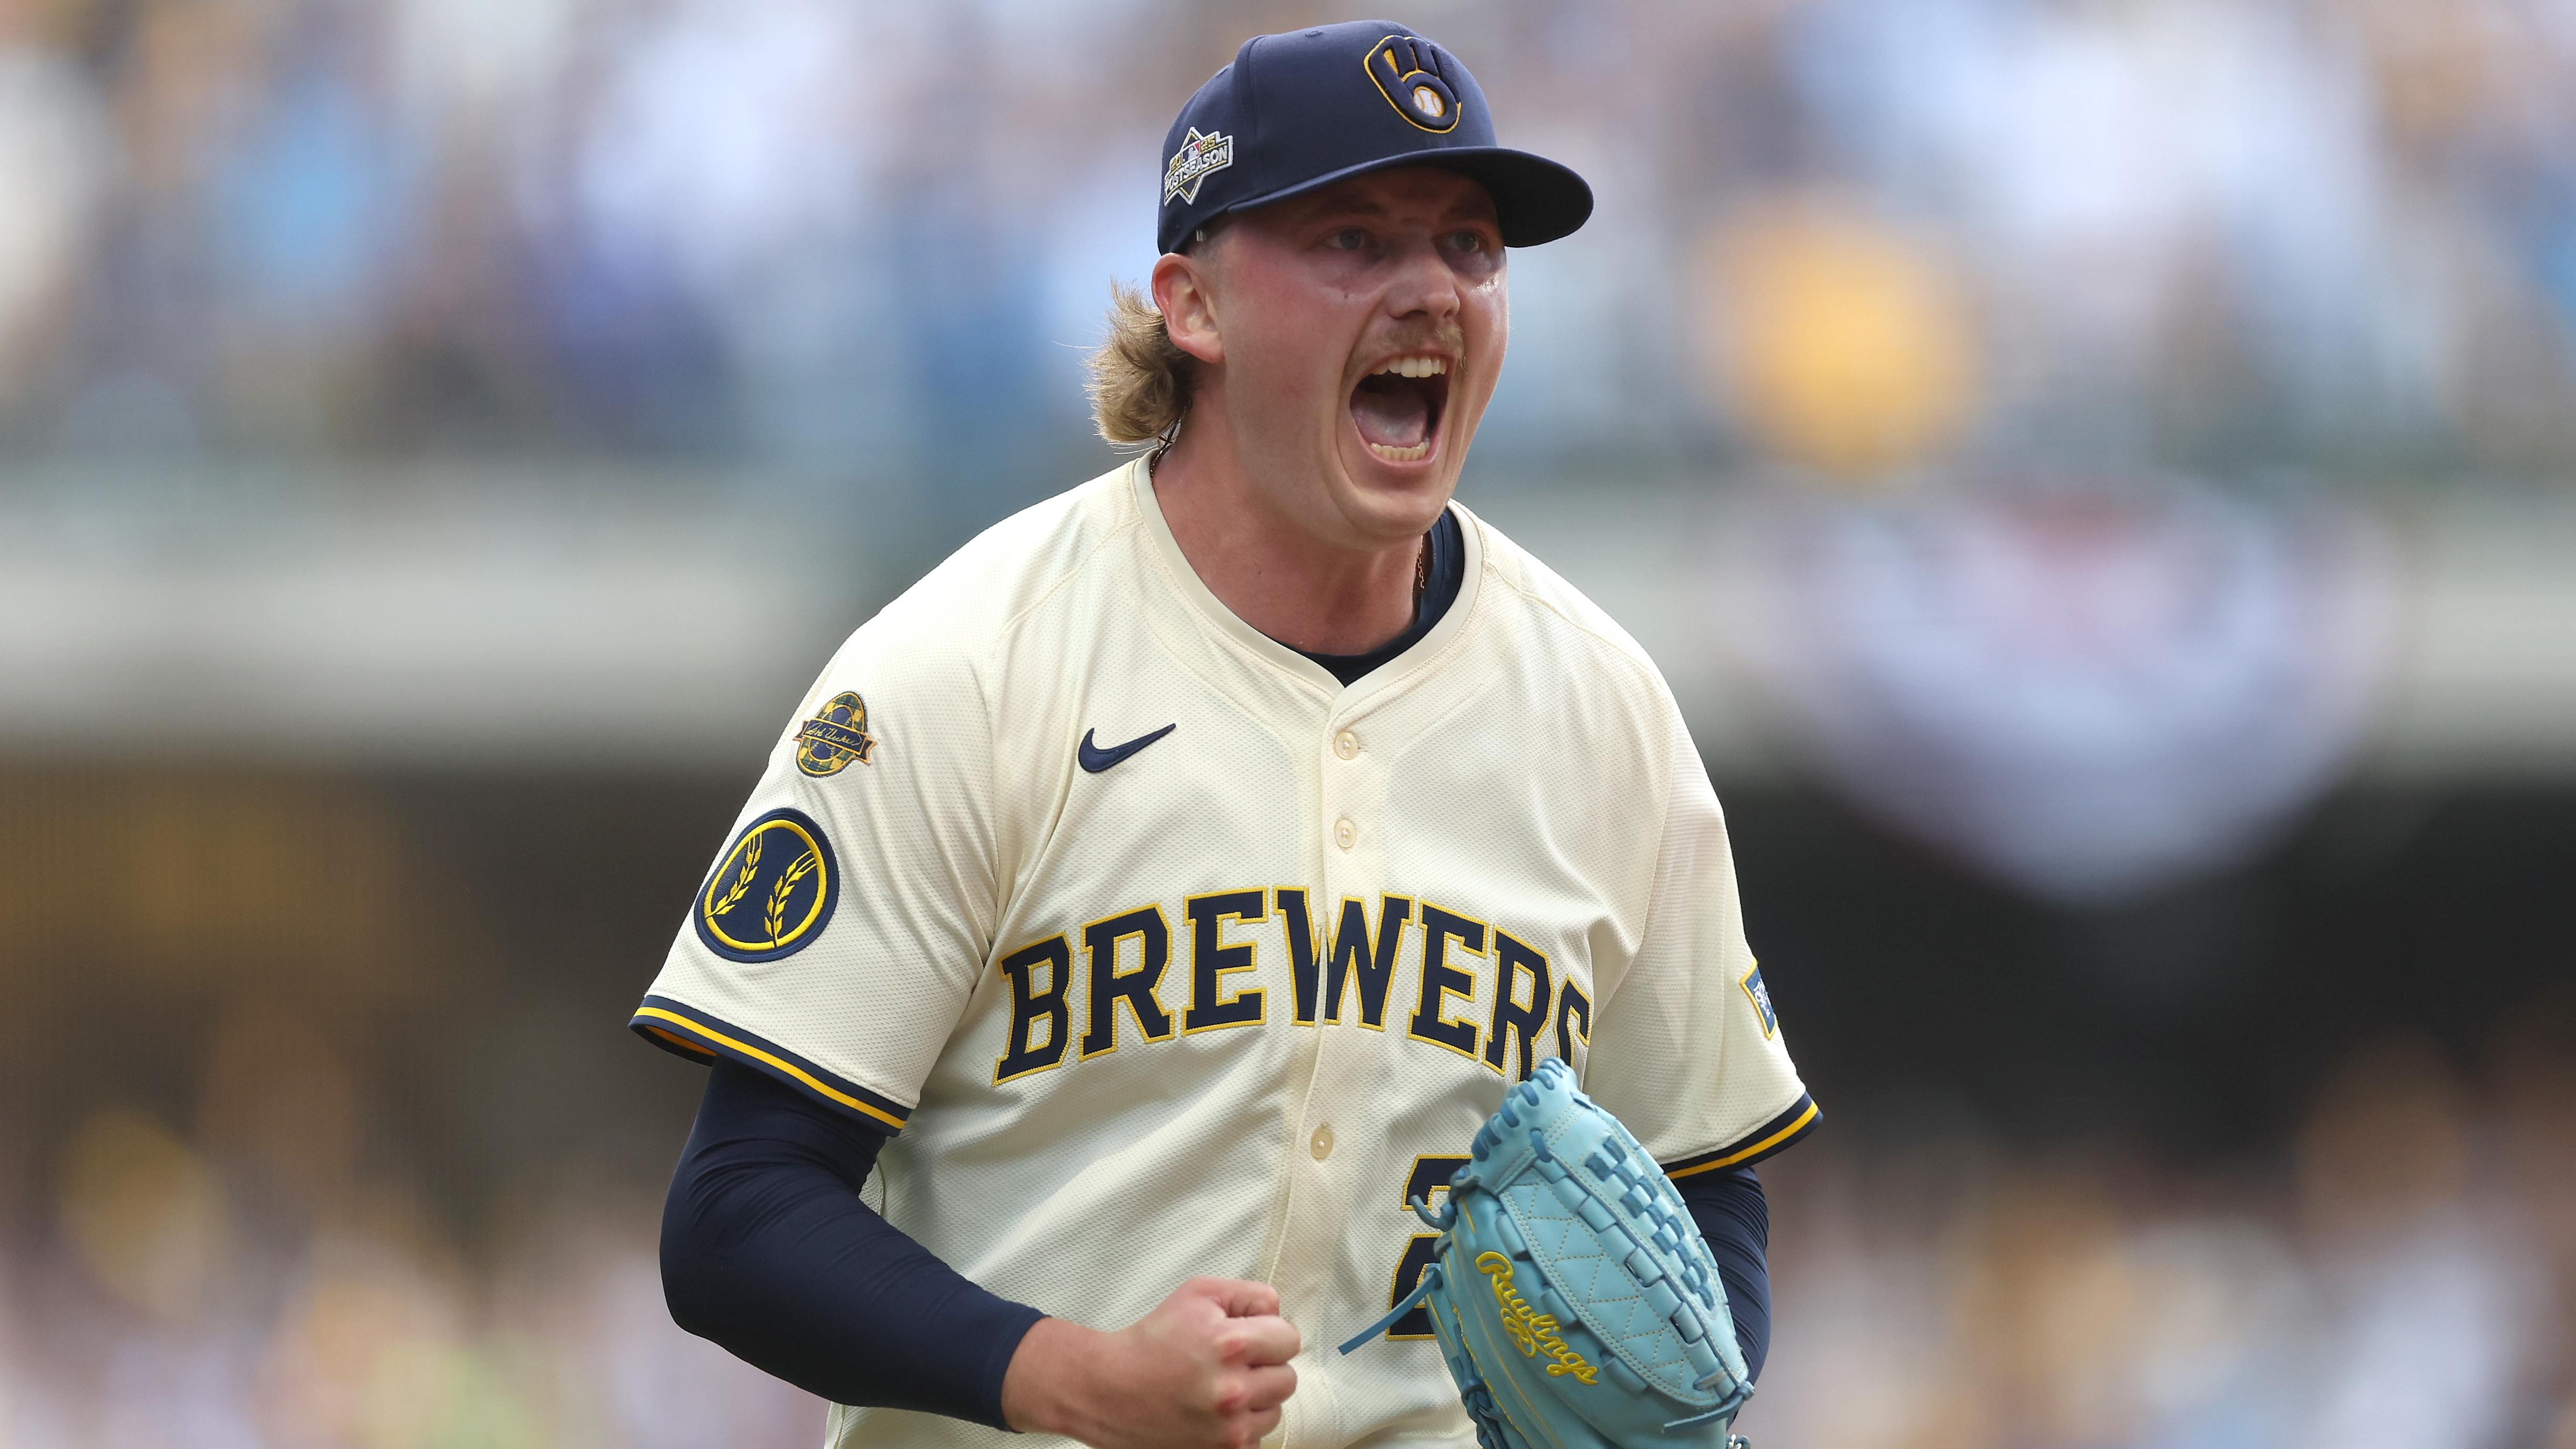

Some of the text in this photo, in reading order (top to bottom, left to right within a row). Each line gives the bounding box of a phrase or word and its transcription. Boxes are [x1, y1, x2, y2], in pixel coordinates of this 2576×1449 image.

[1201, 135, 1215, 151] 25
[1165, 145, 1228, 192] POSTSEASON
[1475, 1251, 1599, 1386] Rawlings
